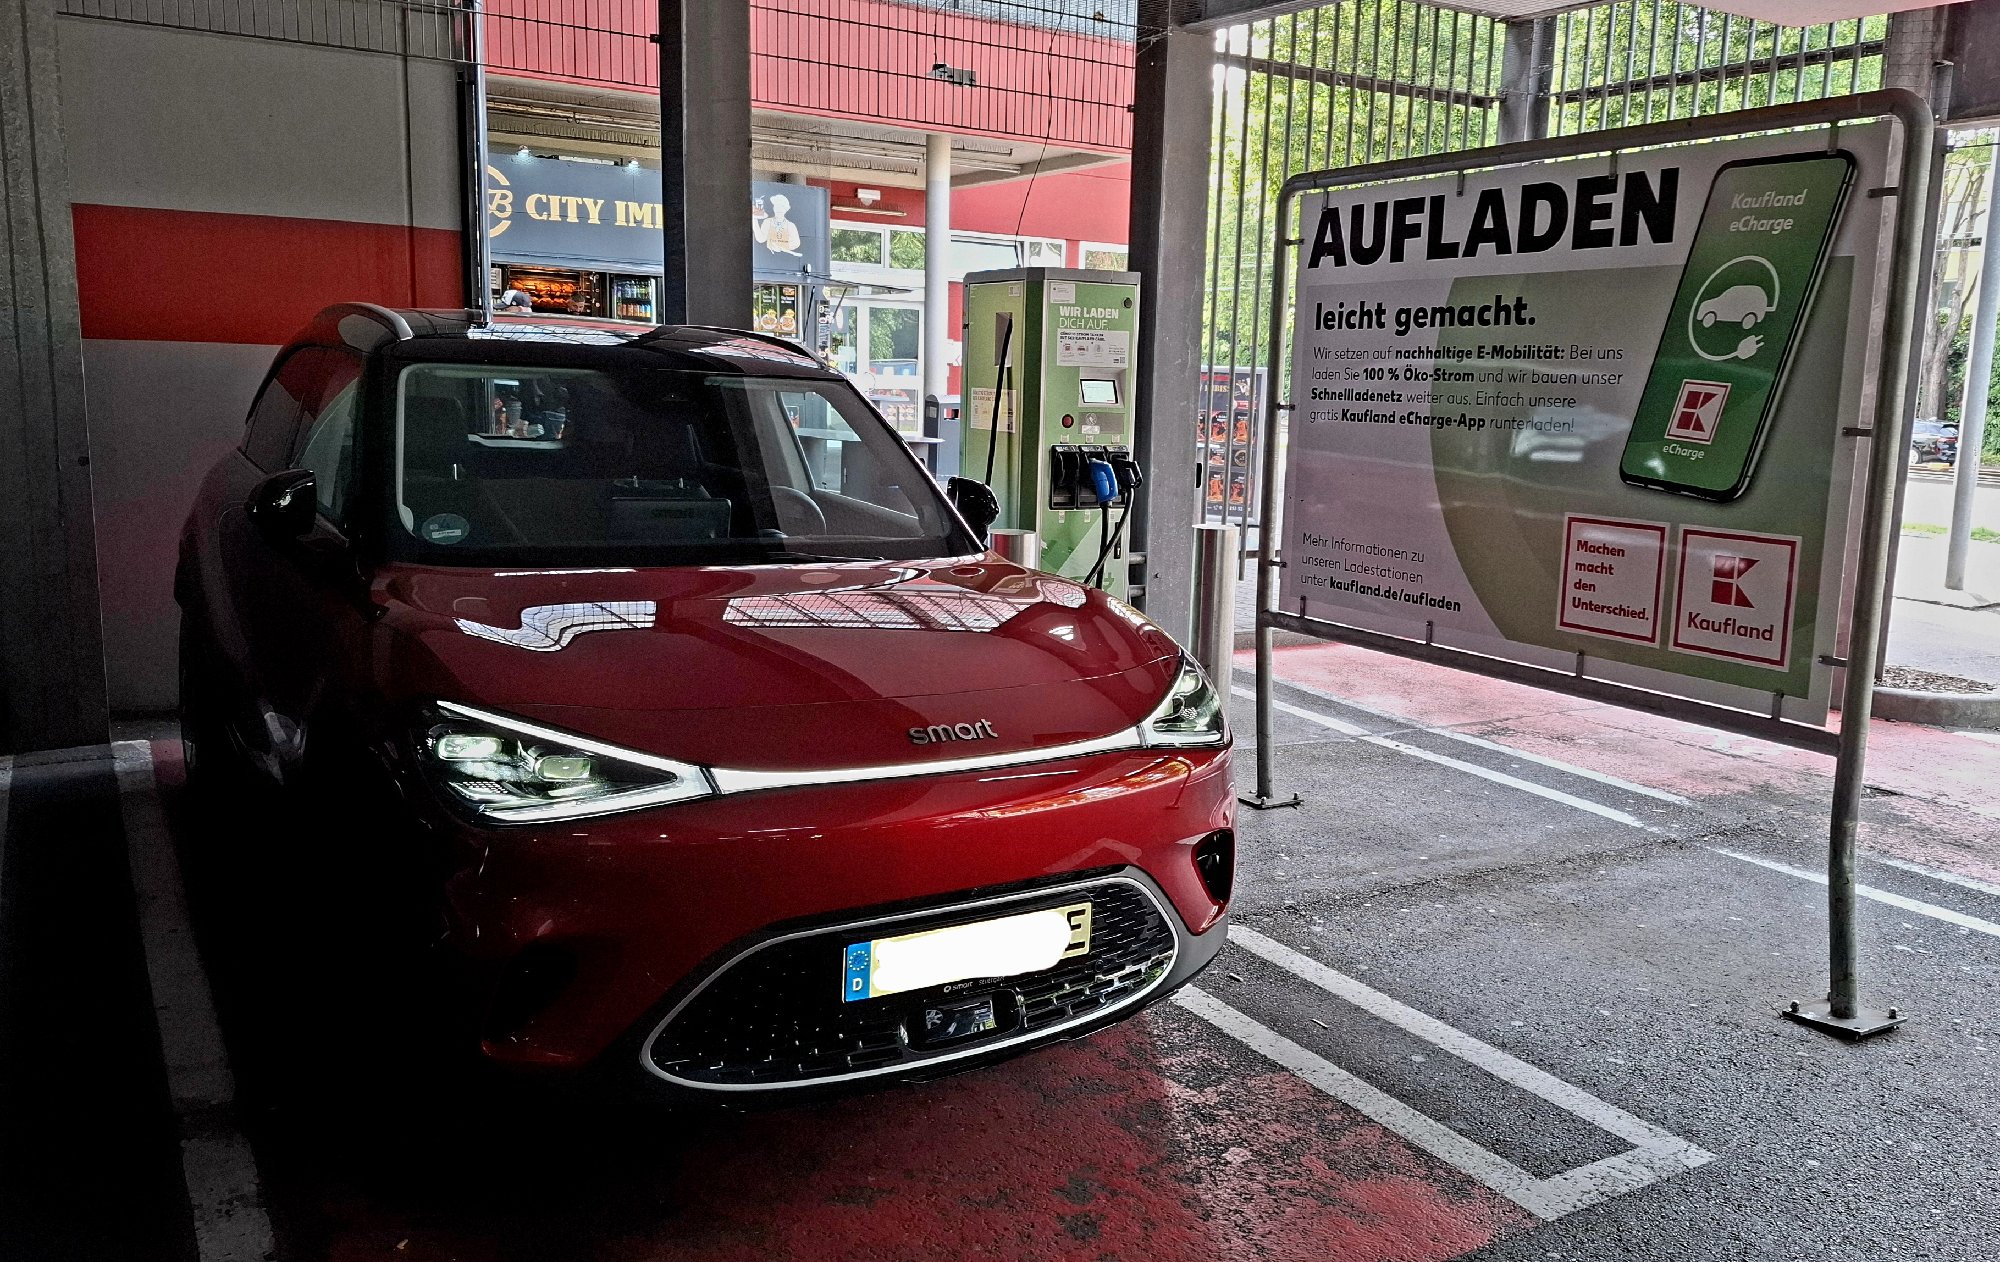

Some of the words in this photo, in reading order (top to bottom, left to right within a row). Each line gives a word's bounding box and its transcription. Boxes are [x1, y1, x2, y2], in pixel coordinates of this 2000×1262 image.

[525, 193, 605, 224] CITY
[1731, 188, 1809, 209] Kaufland
[1308, 168, 1680, 268] AUFLADEN
[1729, 215, 1794, 235] eCharge
[1059, 317, 1085, 329] DICH
[1060, 306, 1081, 318] WIR
[1083, 307, 1119, 319] LADEN
[1315, 301, 1386, 330] leicht
[1395, 295, 1536, 336] gemacht.
[1313, 346, 1332, 359] Wir
[1334, 348, 1369, 360] setzen
[1372, 346, 1393, 359] auf
[1395, 345, 1473, 363] nachhaltige
[1476, 344, 1566, 360] E-Mobilität:
[1569, 344, 1593, 360] Bei
[1597, 348, 1624, 360] uns
[1311, 366, 1341, 381] laden
[1343, 367, 1360, 381] Sie
[1362, 367, 1385, 381] 100
[1388, 367, 1400, 381] %
[1403, 363, 1475, 382] Öko-Strom
[1478, 368, 1504, 383] und
[1507, 370, 1527, 383] wir
[1531, 369, 1577, 385] bauen
[1581, 373, 1624, 385] unser
[1311, 387, 1403, 403] Schnellladenetz
[1406, 391, 1445, 404] weiter
[1447, 394, 1472, 405] aus.
[1475, 390, 1524, 407] Einfach
[1528, 396, 1577, 408] unsere
[1309, 408, 1339, 423] gratis
[1341, 408, 1396, 424] Kaufland
[1399, 411, 1486, 431] eCharge-App
[1489, 416, 1575, 432] runterladen!
[1662, 443, 1705, 460] eCharge
[1302, 532, 1329, 548] Mehr
[1331, 536, 1408, 560] Informationen
[1411, 551, 1425, 563] zu
[1576, 540, 1626, 558] Machen
[1301, 555, 1341, 570] unseren
[1344, 558, 1423, 584] Ladestationen
[1575, 560, 1615, 576] macht
[1300, 573, 1328, 587] unter
[1329, 576, 1461, 612] kaufland.de/aufladen
[1573, 578, 1596, 593] den
[1572, 596, 1650, 621] Unterschied.
[1688, 611, 1775, 641] Kaufland
[909, 718, 999, 745] smart
[852, 977, 863, 991] D
